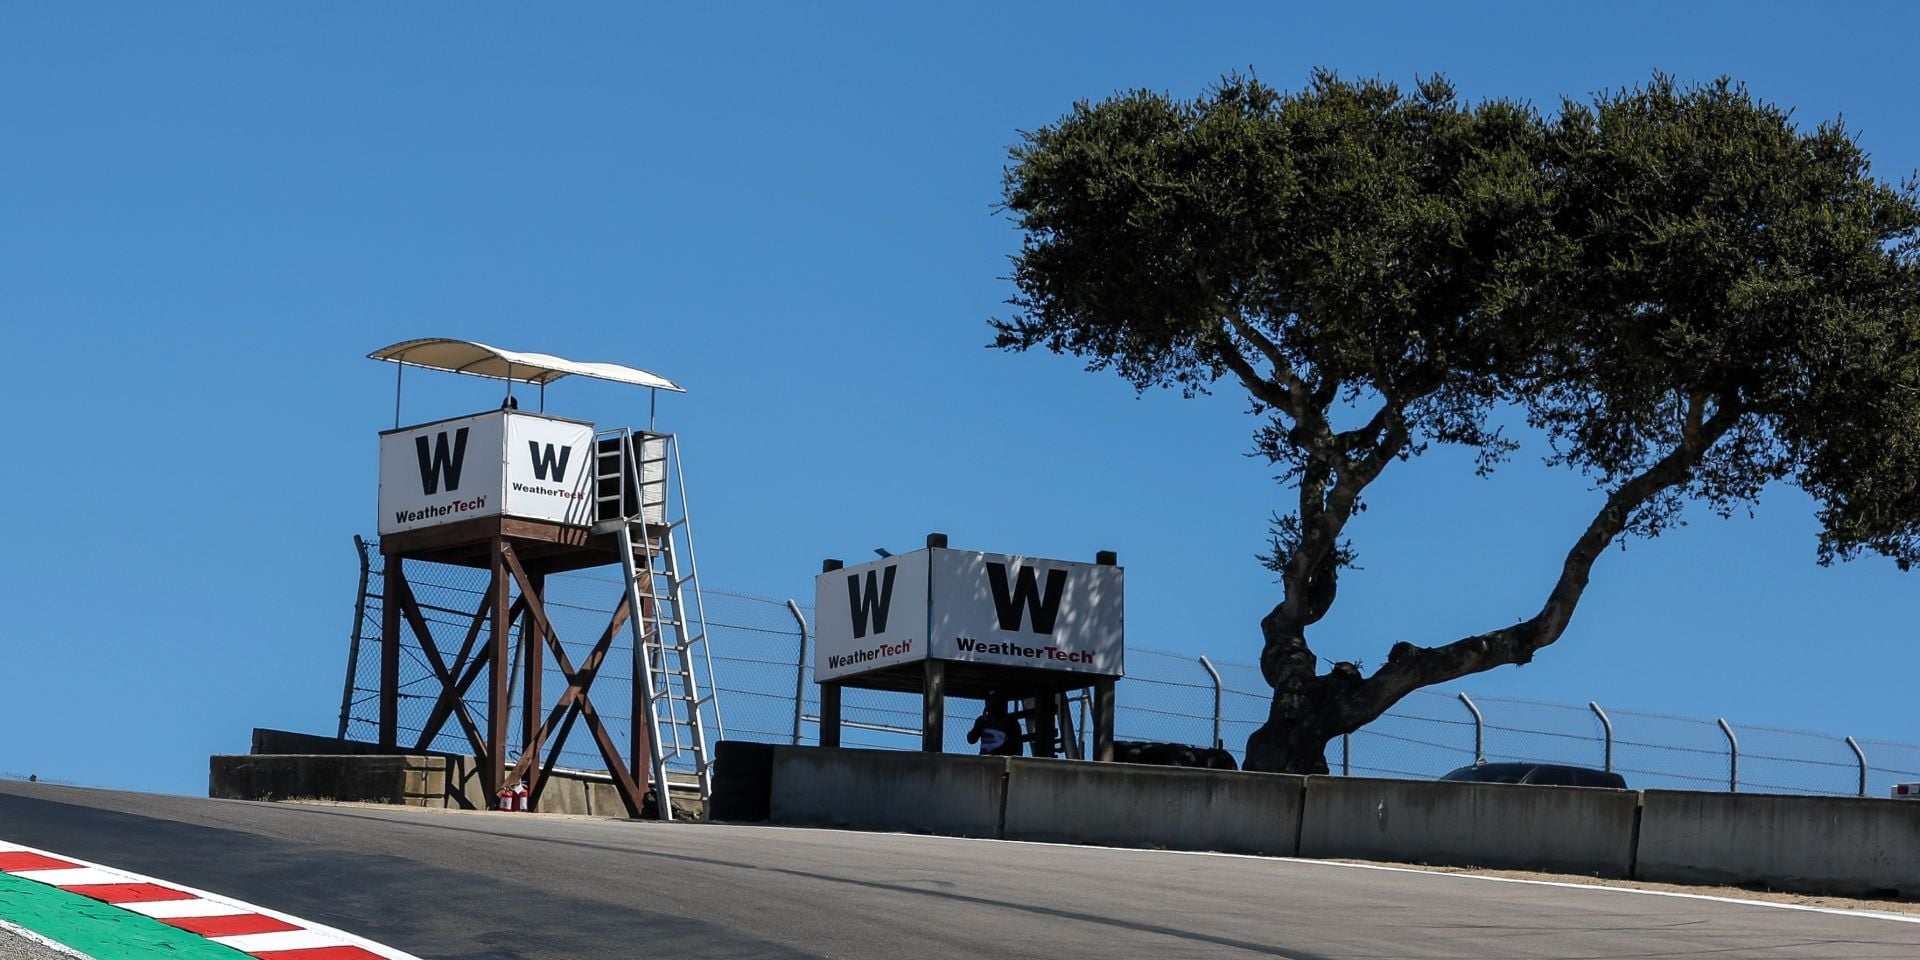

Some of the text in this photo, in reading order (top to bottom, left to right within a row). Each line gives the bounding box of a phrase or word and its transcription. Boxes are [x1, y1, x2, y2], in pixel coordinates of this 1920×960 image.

[415, 427, 470, 495] W
[528, 440, 572, 483] W
[512, 482, 585, 500] WeatherTech
[396, 496, 486, 523] WeatherTech
[847, 564, 897, 639] W
[986, 562, 1068, 635] W
[828, 639, 911, 669] WeatherTech
[956, 637, 1095, 664] WeatherTech
